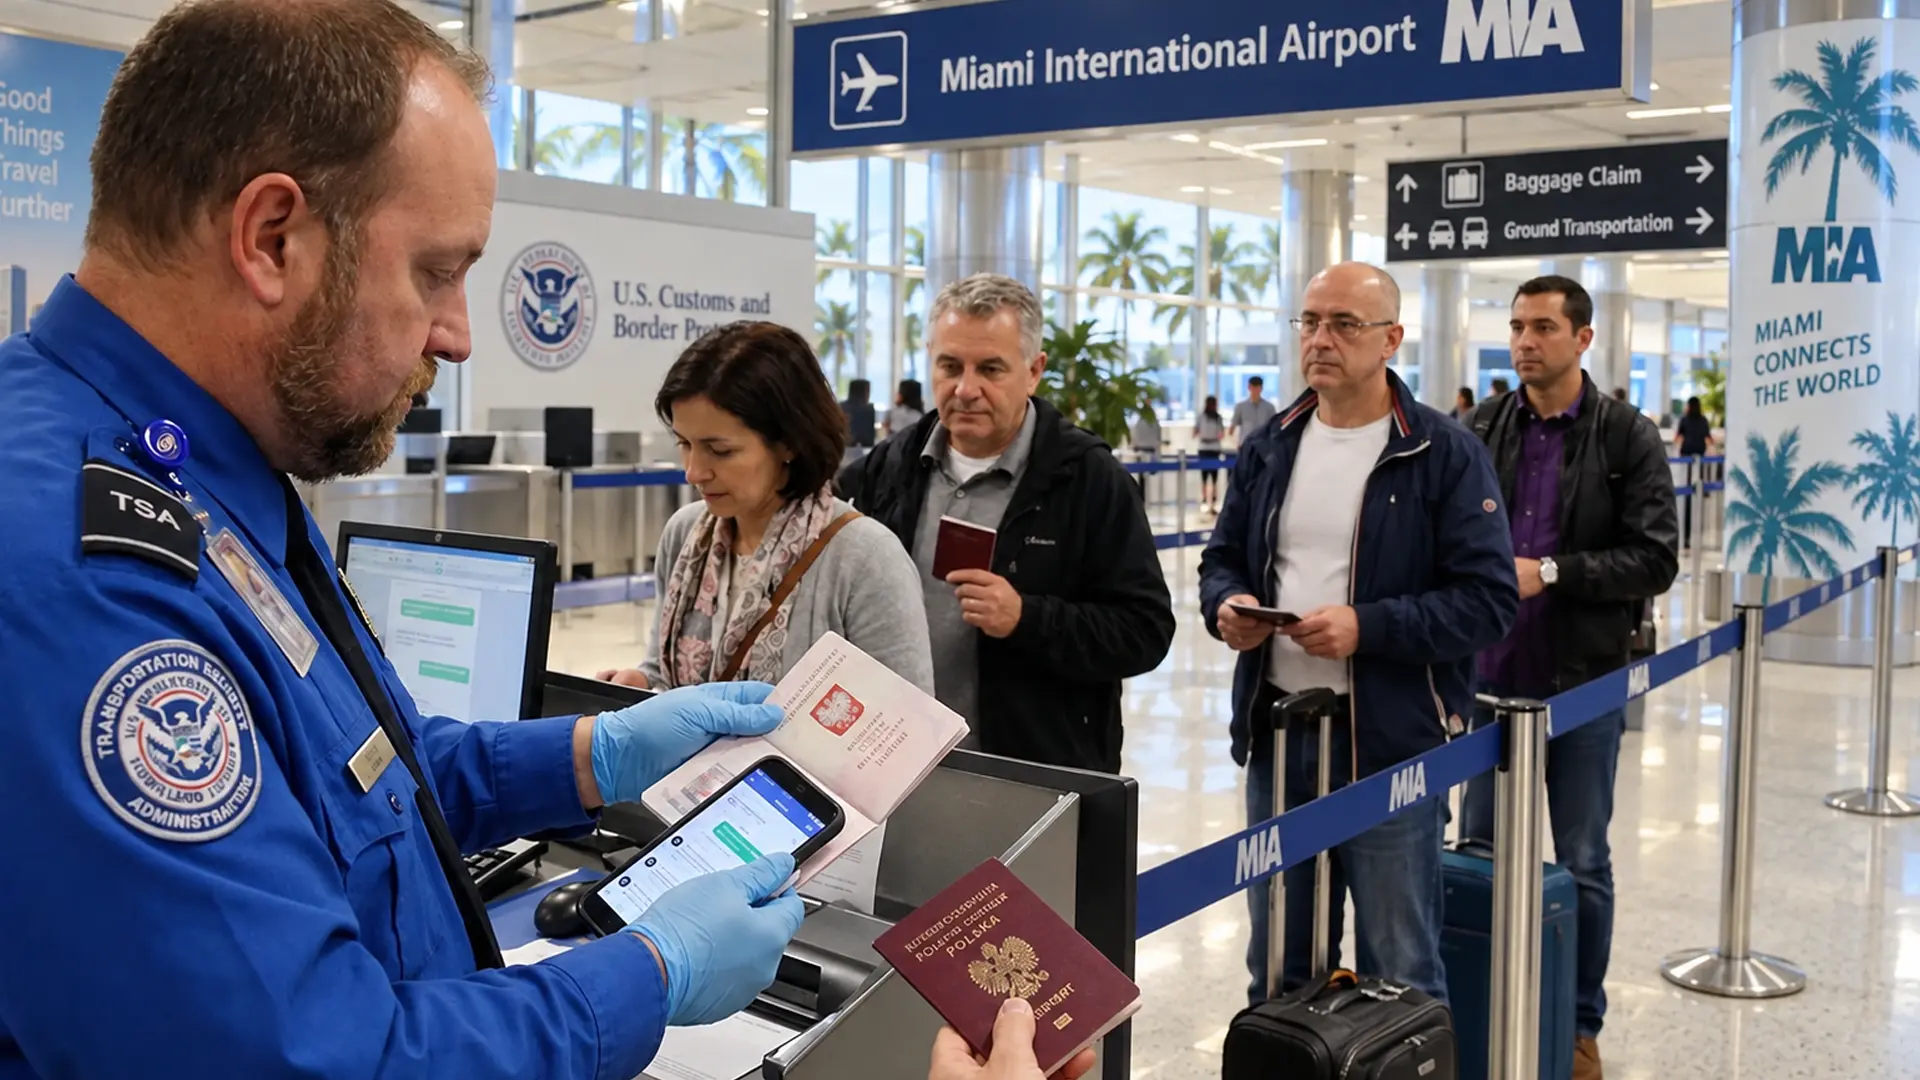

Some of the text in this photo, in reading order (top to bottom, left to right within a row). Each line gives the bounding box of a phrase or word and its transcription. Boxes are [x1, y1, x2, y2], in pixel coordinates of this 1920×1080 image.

[1440, 0, 1585, 65] MIA
[940, 15, 1416, 94] Miami International Airport
[0, 117, 65, 157] hings
[0, 152, 59, 187] ravel
[1504, 165, 1643, 195] Baggage Claim
[0, 189, 75, 222] urther
[1503, 213, 1674, 240] Ground Transportation
[1771, 226, 1882, 284] MIA
[613, 280, 771, 315] U.S. Customs and
[613, 313, 679, 341] Border
[1754, 309, 1823, 345] MIAMI
[1753, 333, 1873, 377] CONNECTS
[1753, 363, 1882, 408] THE WORLD
[110, 489, 182, 532] TSA
[1388, 761, 1427, 813] MIA
[1234, 824, 1283, 886] MIA
